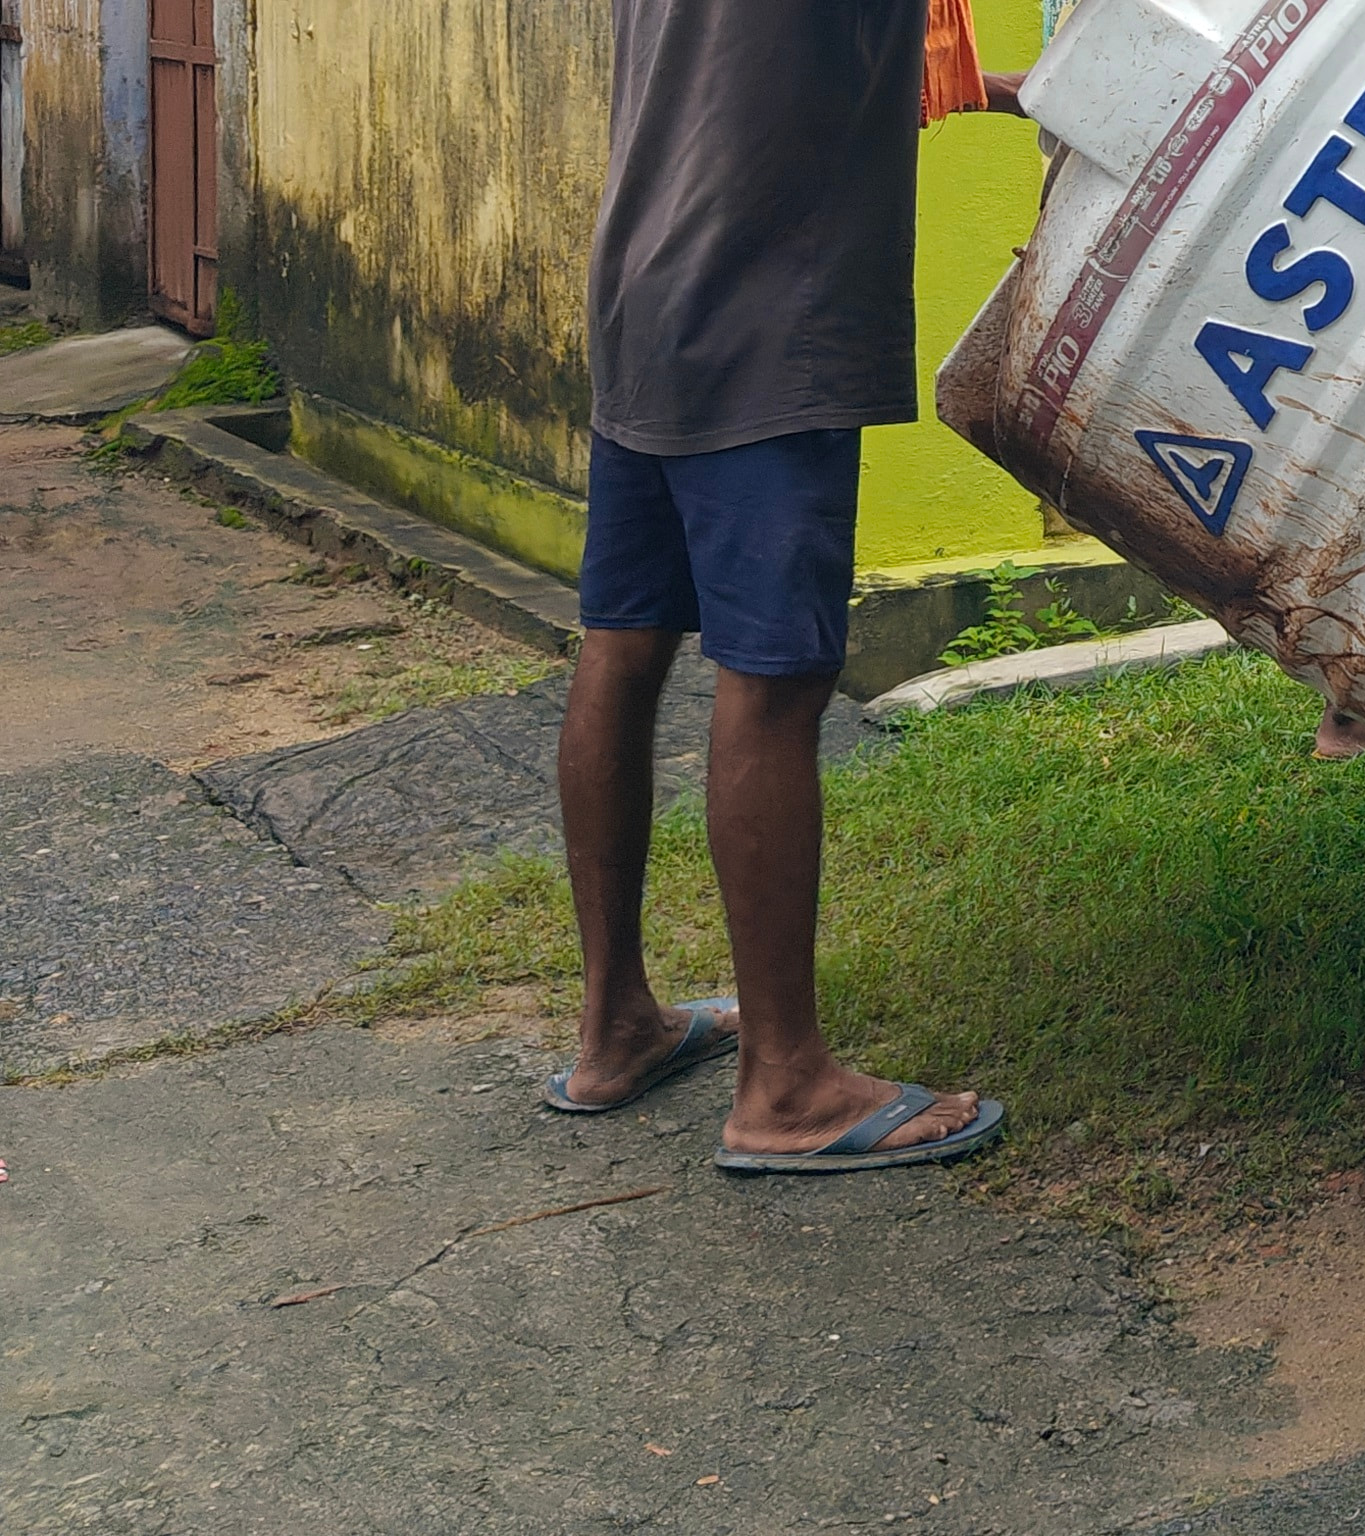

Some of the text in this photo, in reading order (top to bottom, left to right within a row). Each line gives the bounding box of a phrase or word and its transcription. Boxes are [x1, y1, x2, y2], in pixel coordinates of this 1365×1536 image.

[1240, 12, 1271, 48] ASTRAL
[1083, 278, 1104, 306] WATER
[1090, 289, 1107, 313] TANK
[1068, 300, 1095, 328] 3
[1037, 332, 1086, 394] PIO
